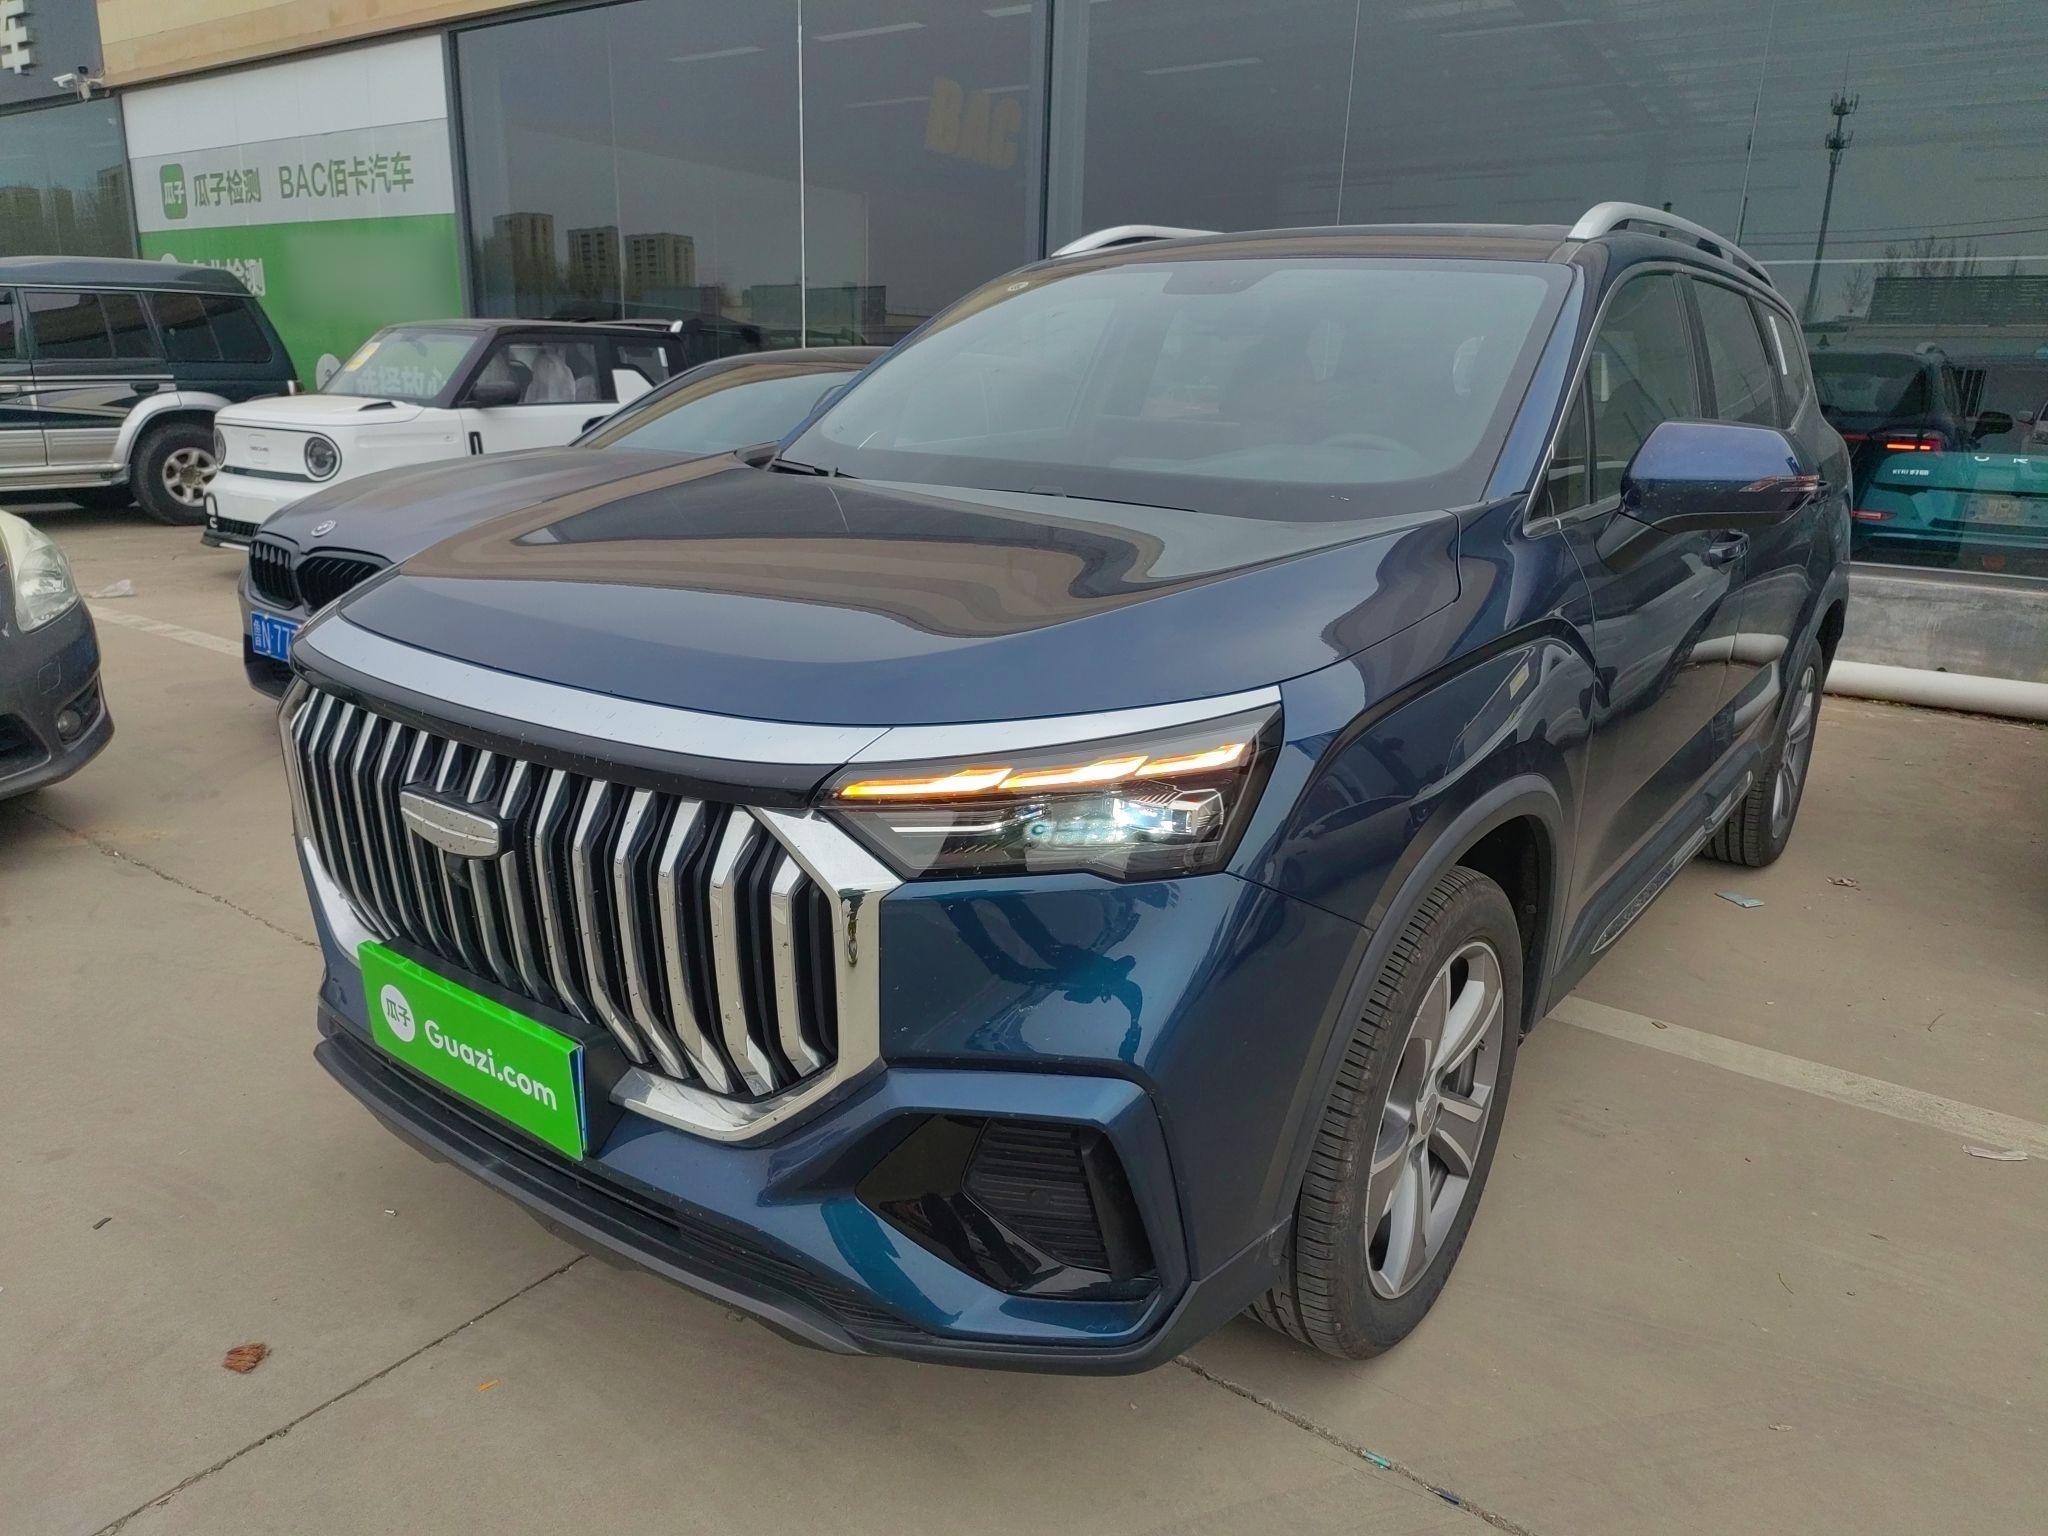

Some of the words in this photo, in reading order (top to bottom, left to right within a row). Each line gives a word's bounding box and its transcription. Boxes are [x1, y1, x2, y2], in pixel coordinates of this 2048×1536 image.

[164, 181, 185, 205] 瓜子
[193, 168, 262, 208] 瓜子检测
[279, 152, 414, 199] BAC佰卡汽车
[386, 997, 411, 1028] 瓜子
[424, 1020, 558, 1111] Guazi.com
